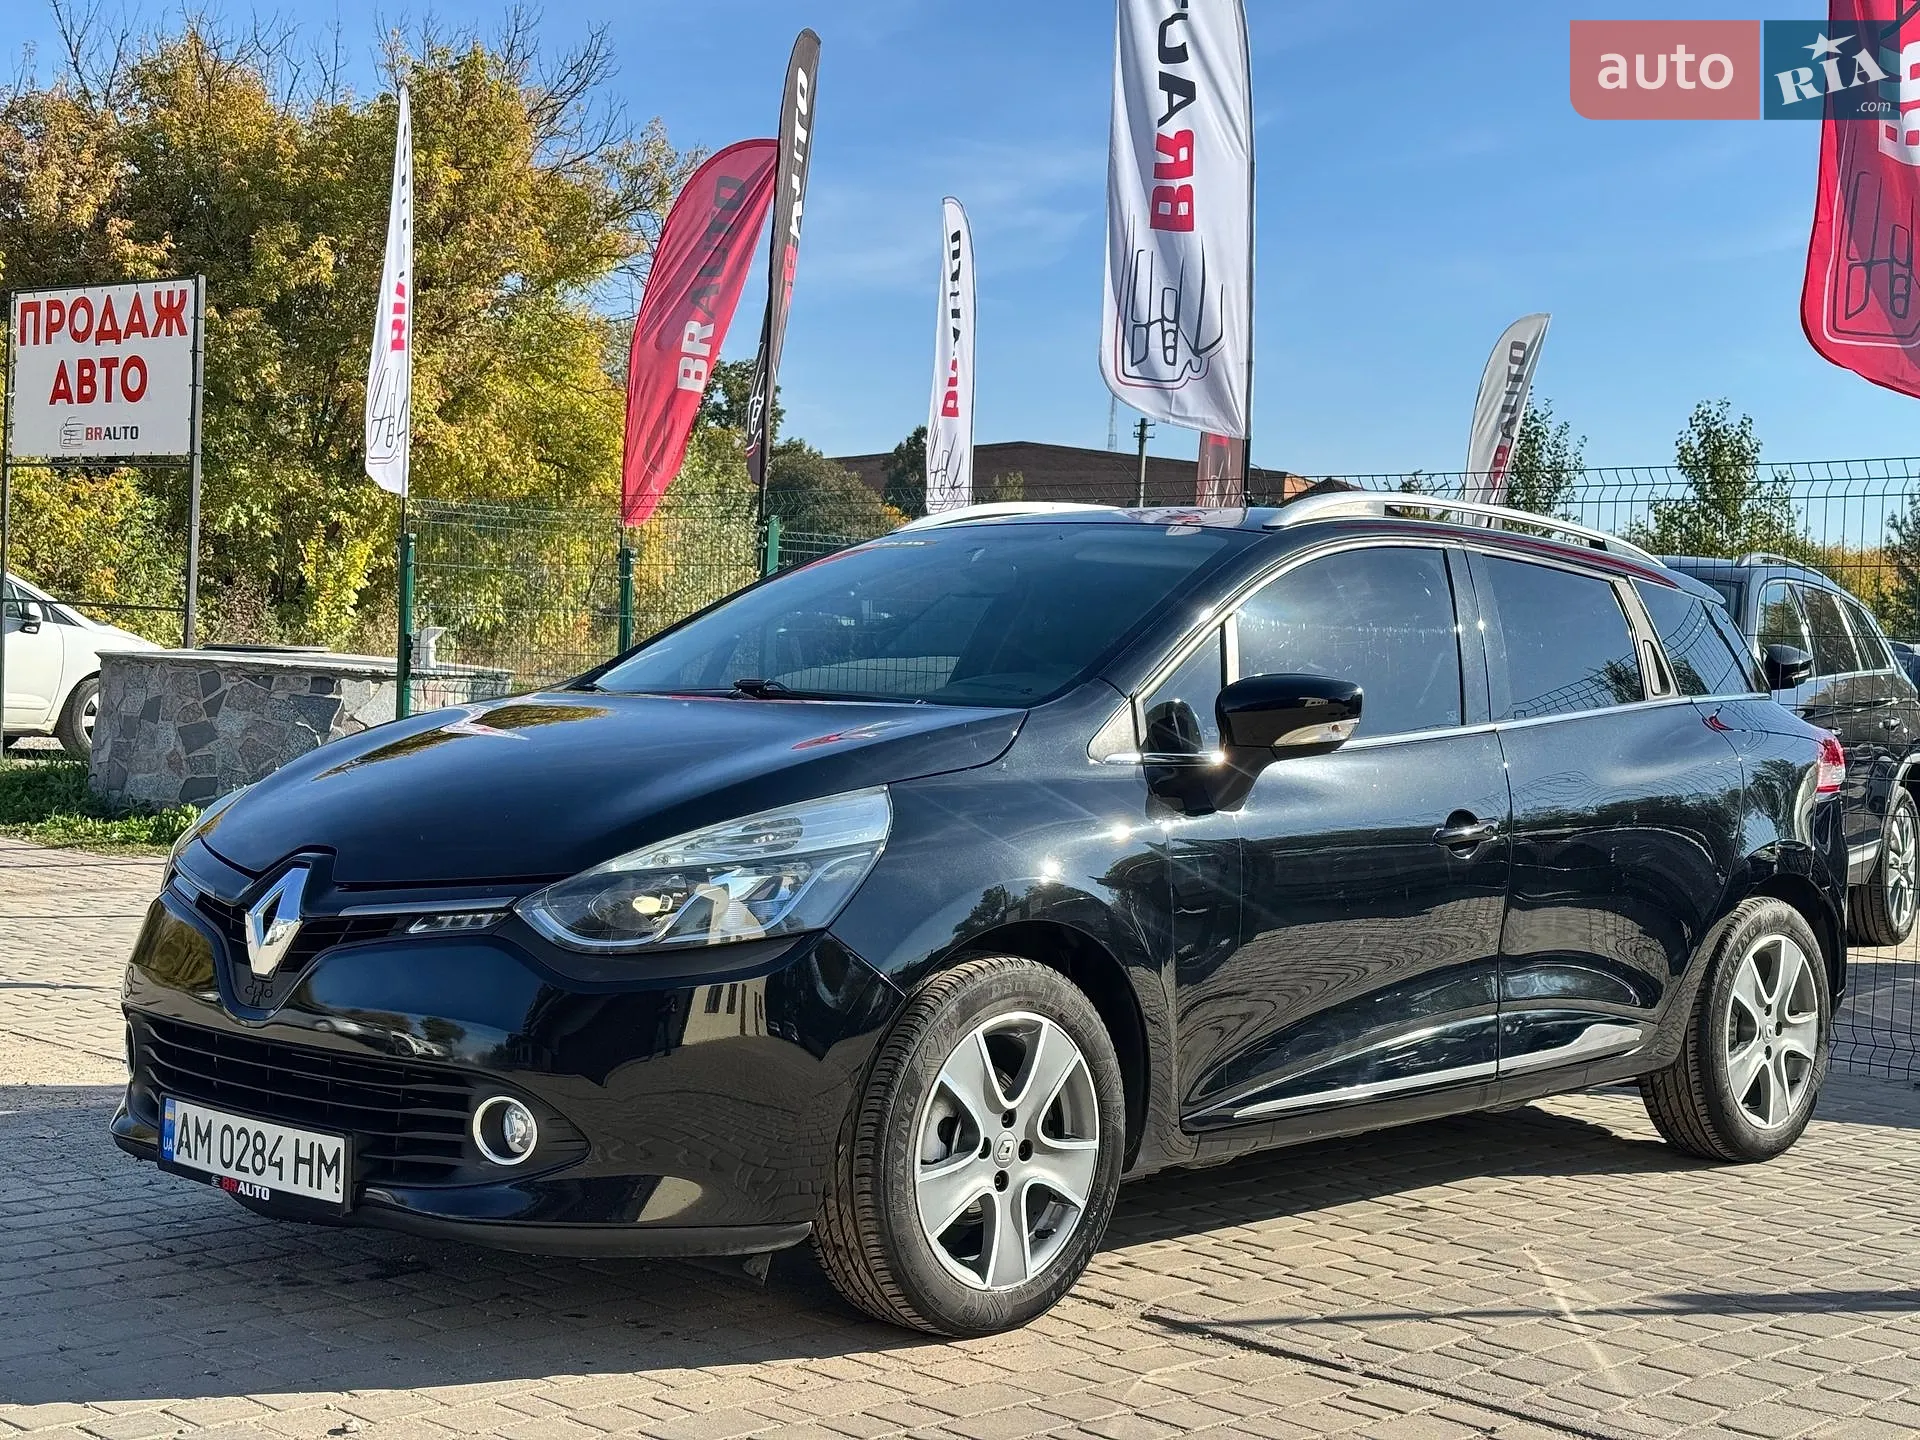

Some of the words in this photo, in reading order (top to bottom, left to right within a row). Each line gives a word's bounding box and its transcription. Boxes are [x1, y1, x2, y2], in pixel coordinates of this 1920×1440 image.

[677, 175, 747, 393] BRAUTO
[19, 289, 188, 346] ПРОДАЖ
[48, 354, 148, 405] АВТО
[85, 426, 139, 441] BRAUTO
[163, 1138, 173, 1152] UA
[176, 1112, 212, 1165] AM
[219, 1123, 283, 1181] 0284
[294, 1138, 341, 1194] HM
[220, 1176, 270, 1201] BRAUTO
